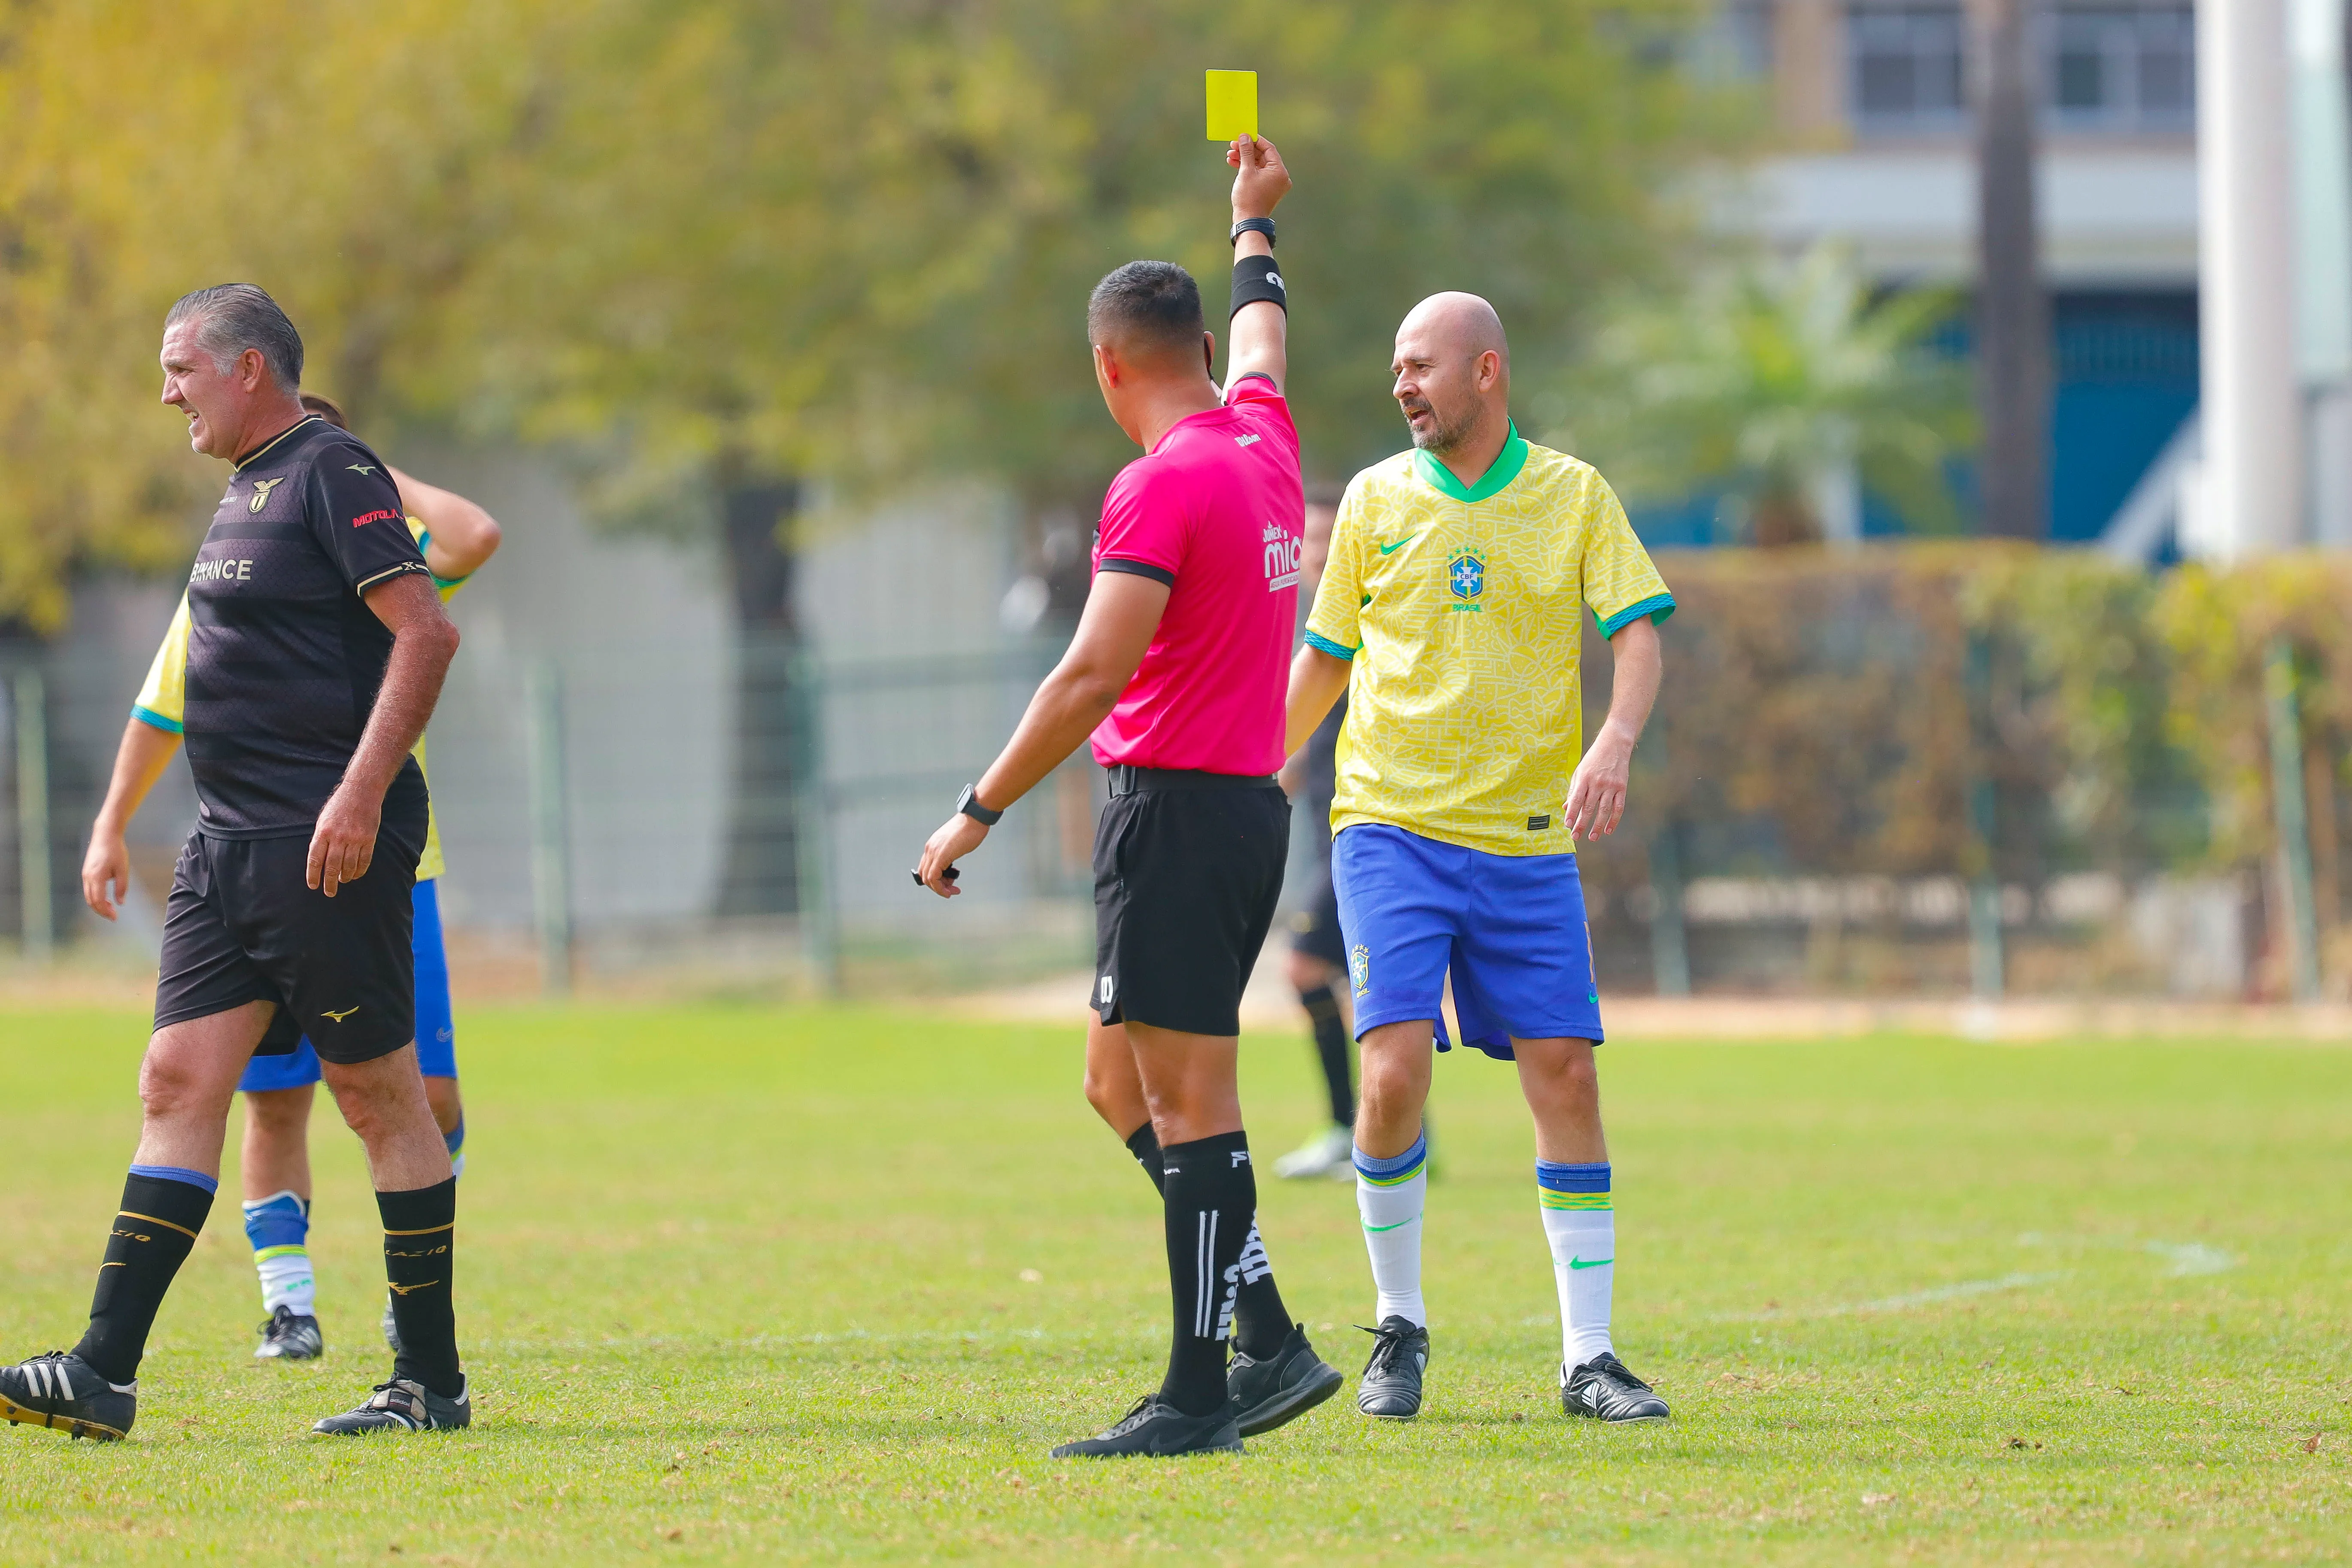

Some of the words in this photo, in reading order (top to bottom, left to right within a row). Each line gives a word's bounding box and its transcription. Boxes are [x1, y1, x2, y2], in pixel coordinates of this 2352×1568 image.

[1263, 525, 1282, 543] JUMEX
[190, 559, 253, 582] BINANCE
[1452, 604, 1482, 612] BRASIL
